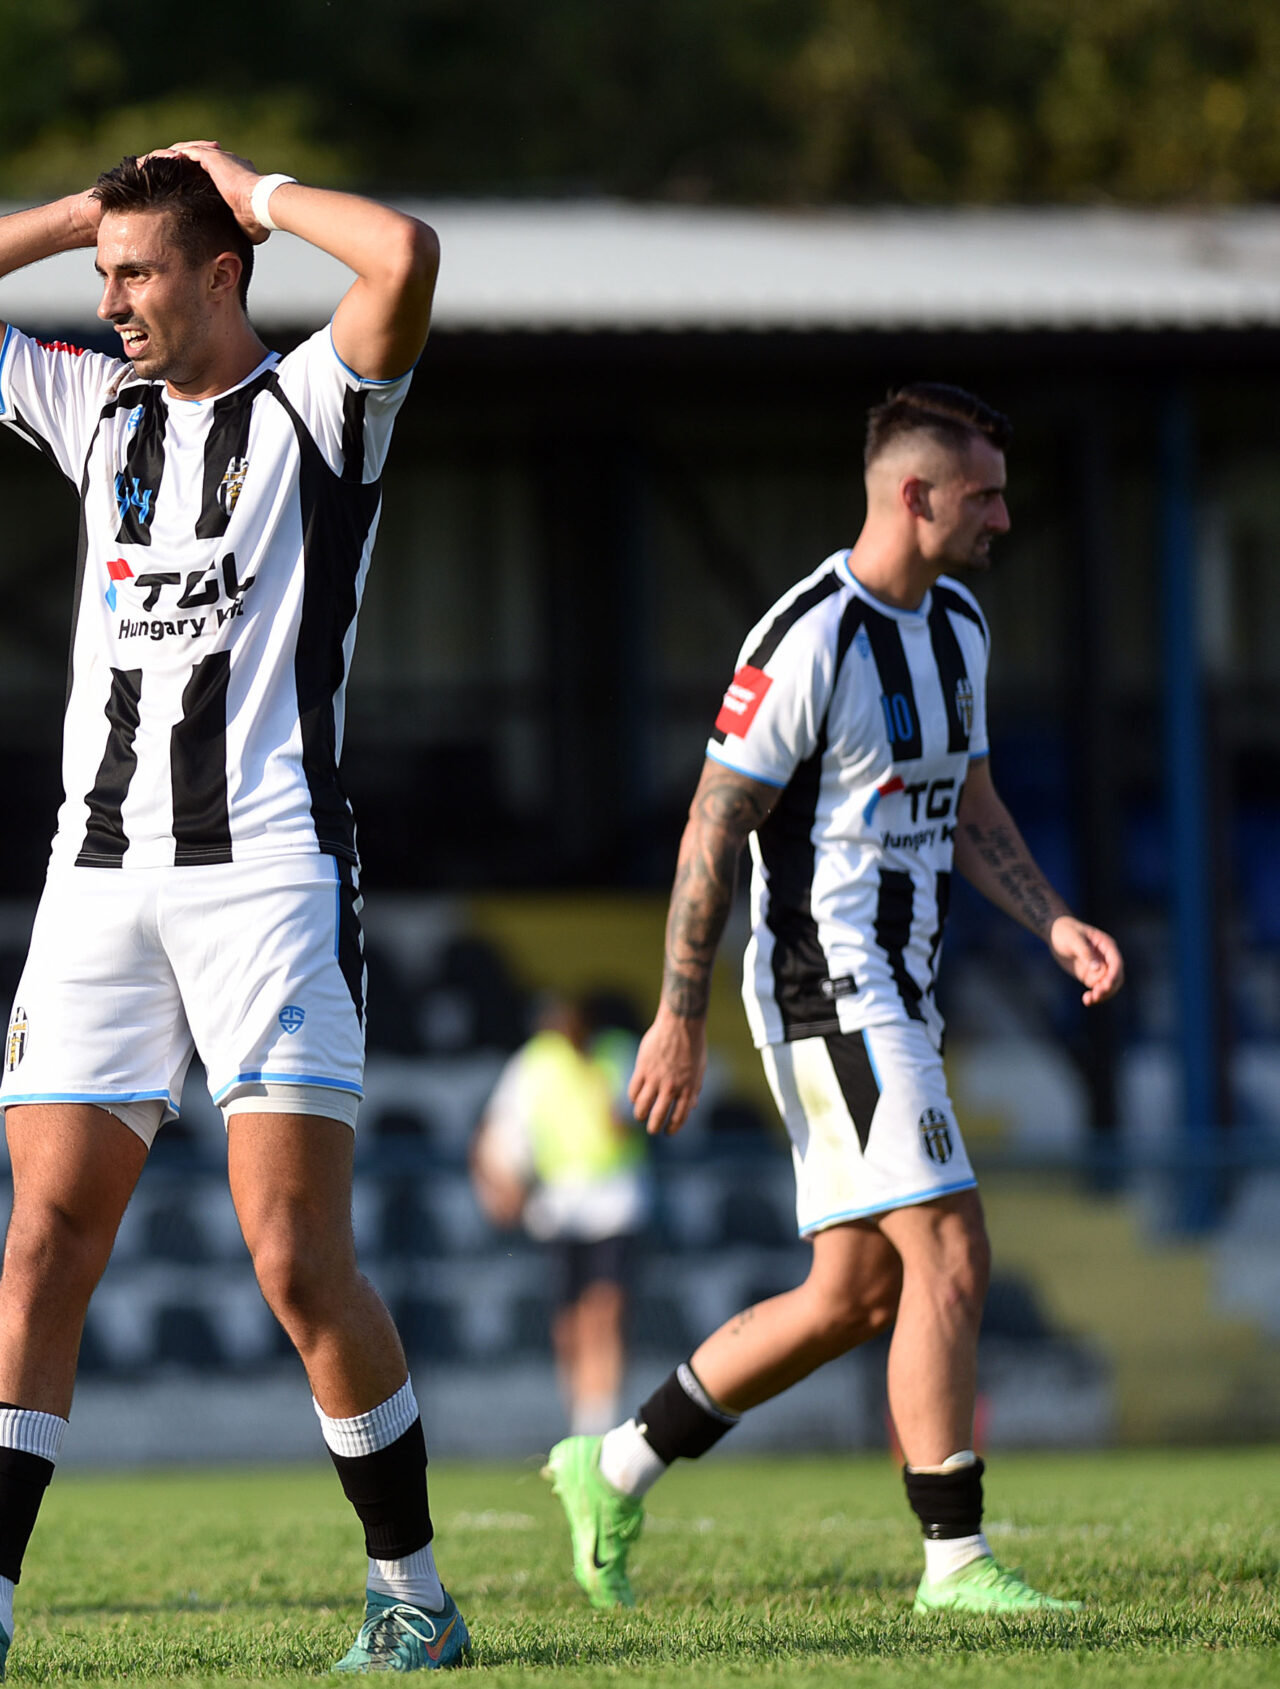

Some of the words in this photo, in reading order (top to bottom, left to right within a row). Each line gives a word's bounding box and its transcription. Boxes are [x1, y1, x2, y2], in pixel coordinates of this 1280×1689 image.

[134, 552, 256, 612] TGL
[118, 616, 207, 641] Hungary
[881, 693, 913, 743] 10
